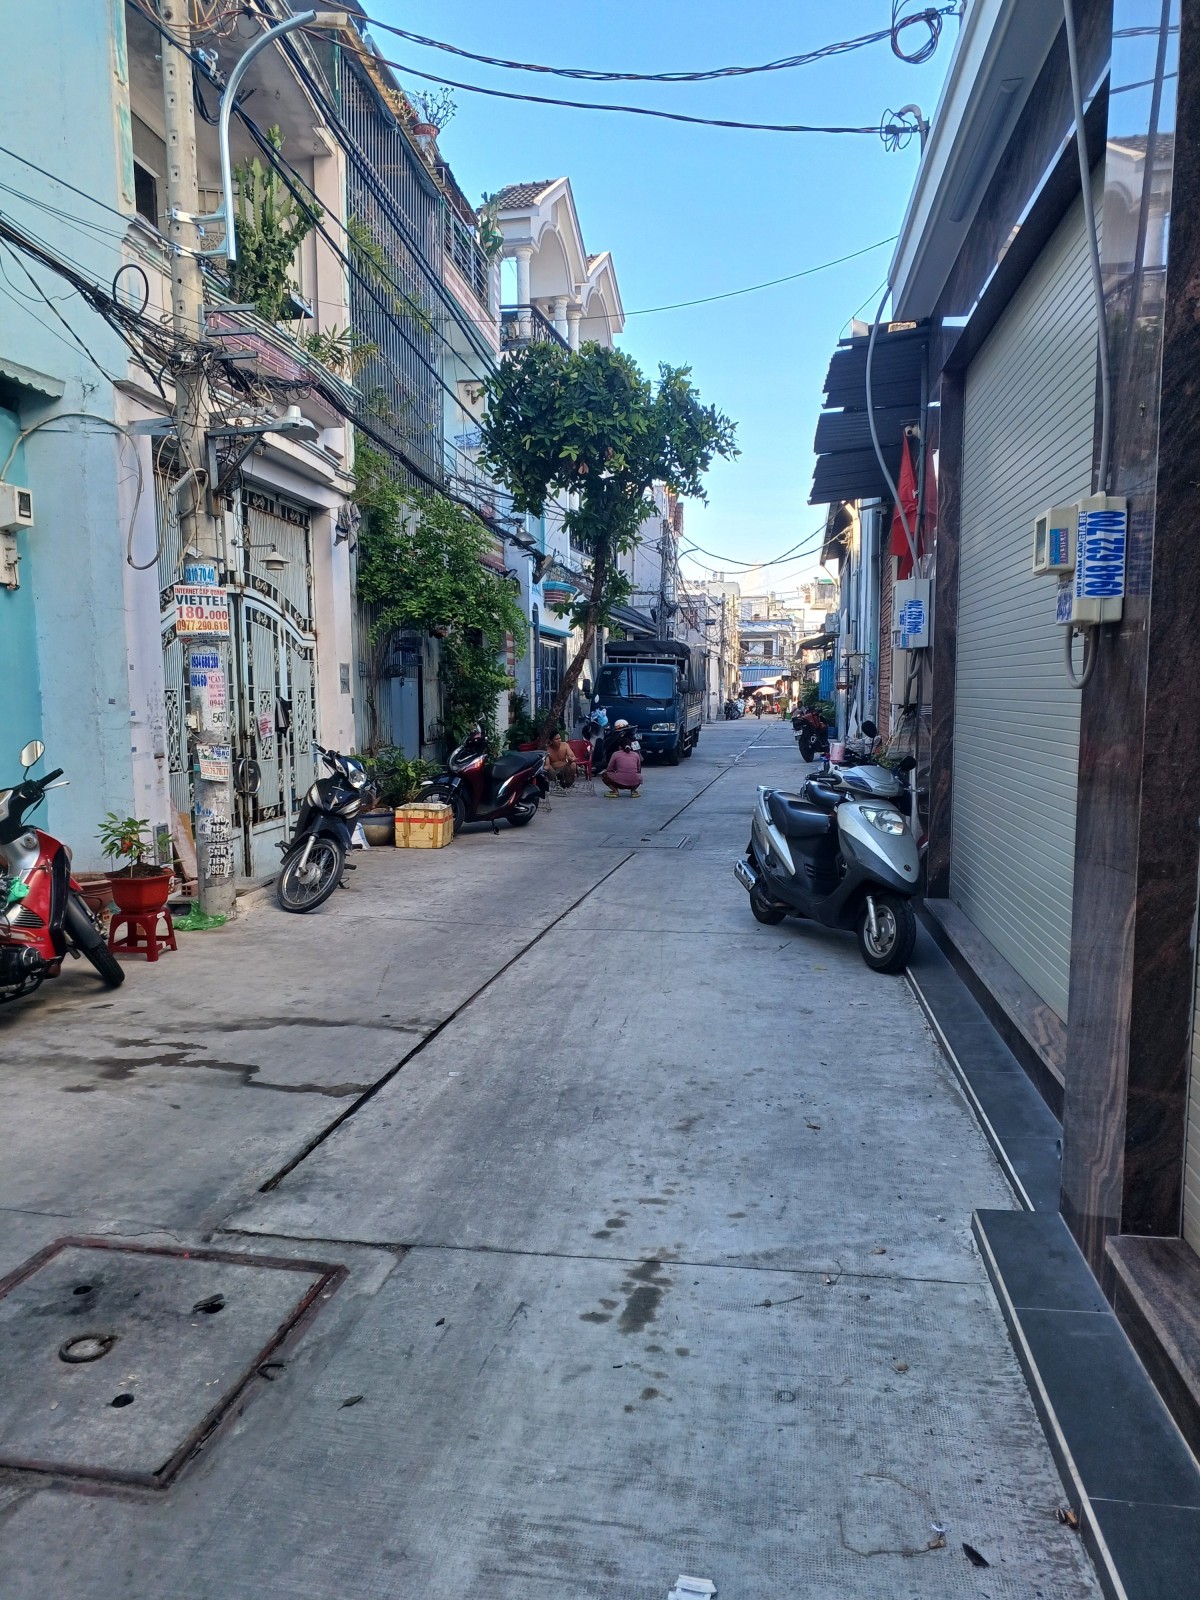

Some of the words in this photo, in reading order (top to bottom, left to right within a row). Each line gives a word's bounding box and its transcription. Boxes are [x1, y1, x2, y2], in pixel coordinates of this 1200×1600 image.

[1085, 511, 1125, 596] 0948.622.700
[175, 587, 198, 595] INTERNET
[175, 595, 226, 606] VIETTEL
[176, 606, 228, 620] 180.000
[177, 619, 228, 631] 0977.290.618
